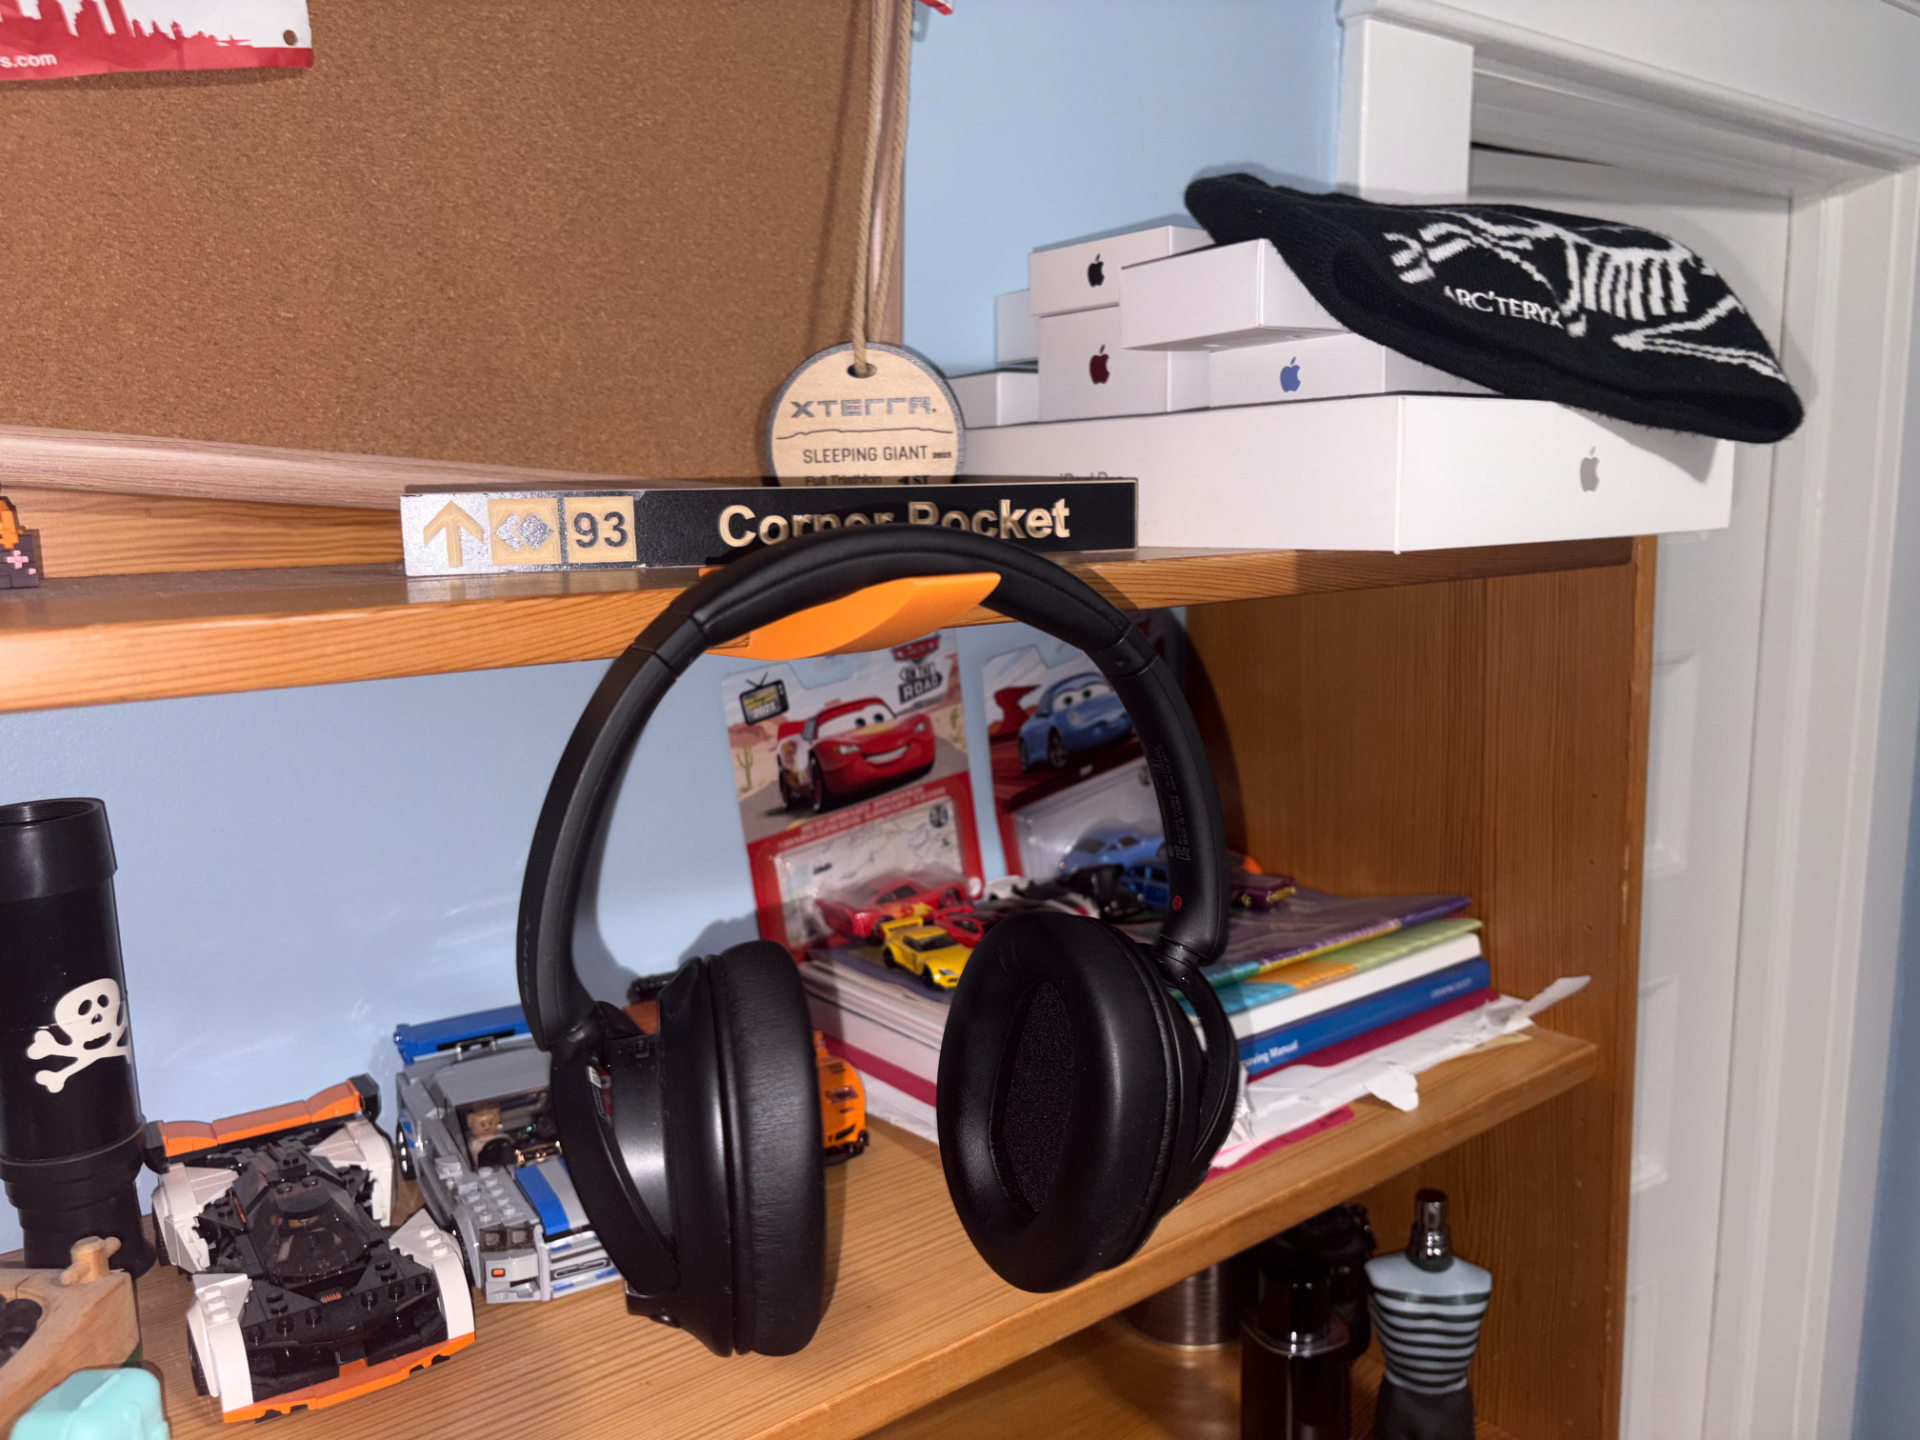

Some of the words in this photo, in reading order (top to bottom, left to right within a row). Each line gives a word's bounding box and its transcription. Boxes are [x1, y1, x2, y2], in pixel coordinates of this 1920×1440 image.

[803, 447, 878, 464] SLEEPING
[883, 445, 928, 462] GIANT
[573, 511, 629, 549] 93
[1269, 1040, 1299, 1058] Manual
